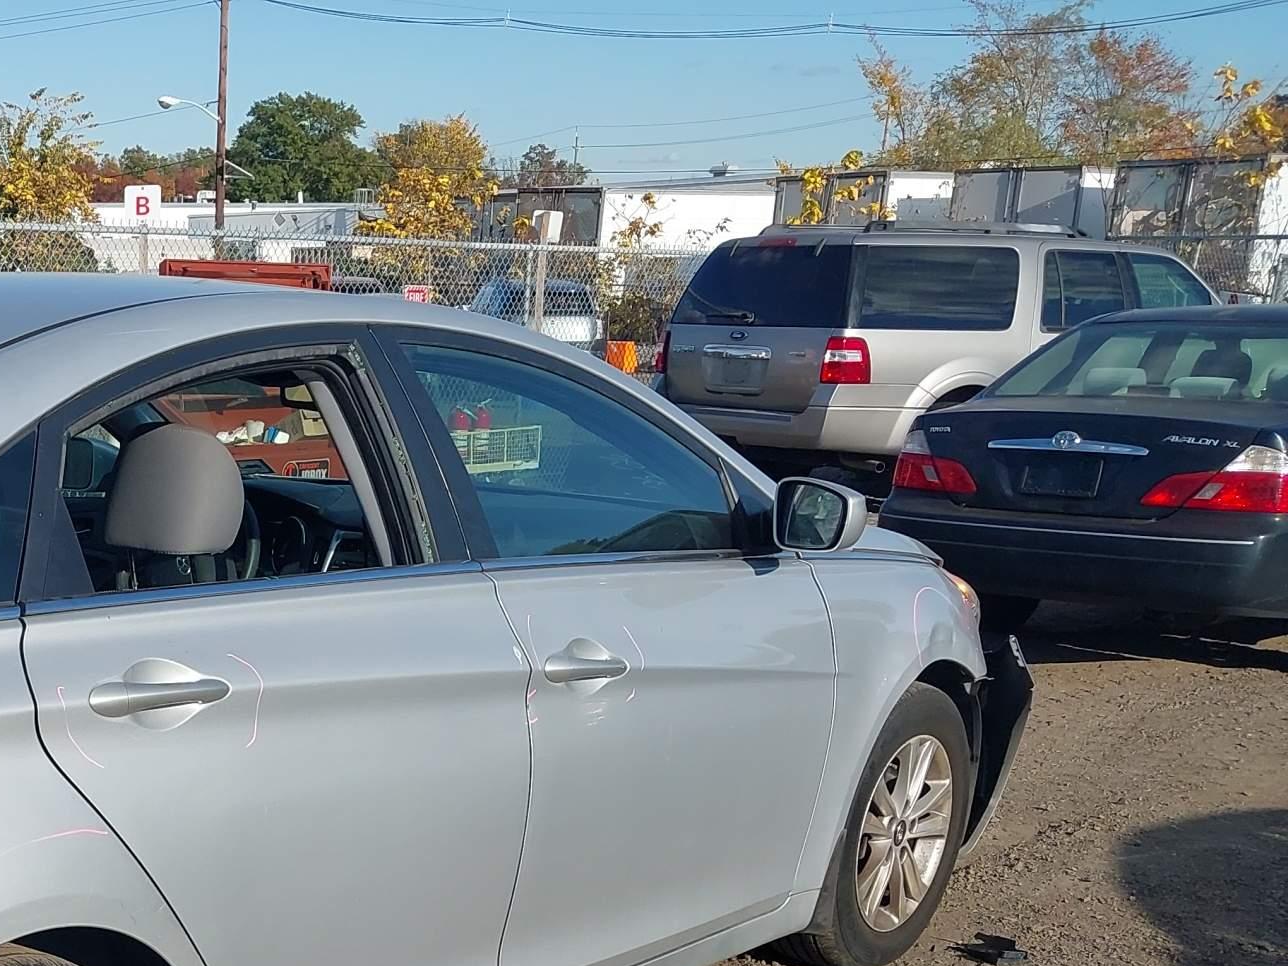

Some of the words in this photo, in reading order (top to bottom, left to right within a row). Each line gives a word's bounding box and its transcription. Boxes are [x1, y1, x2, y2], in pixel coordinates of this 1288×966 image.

[135, 196, 150, 216] B
[408, 292, 426, 303] FIRE
[1162, 435, 1220, 446] AVALON
[1223, 440, 1241, 449] XL
